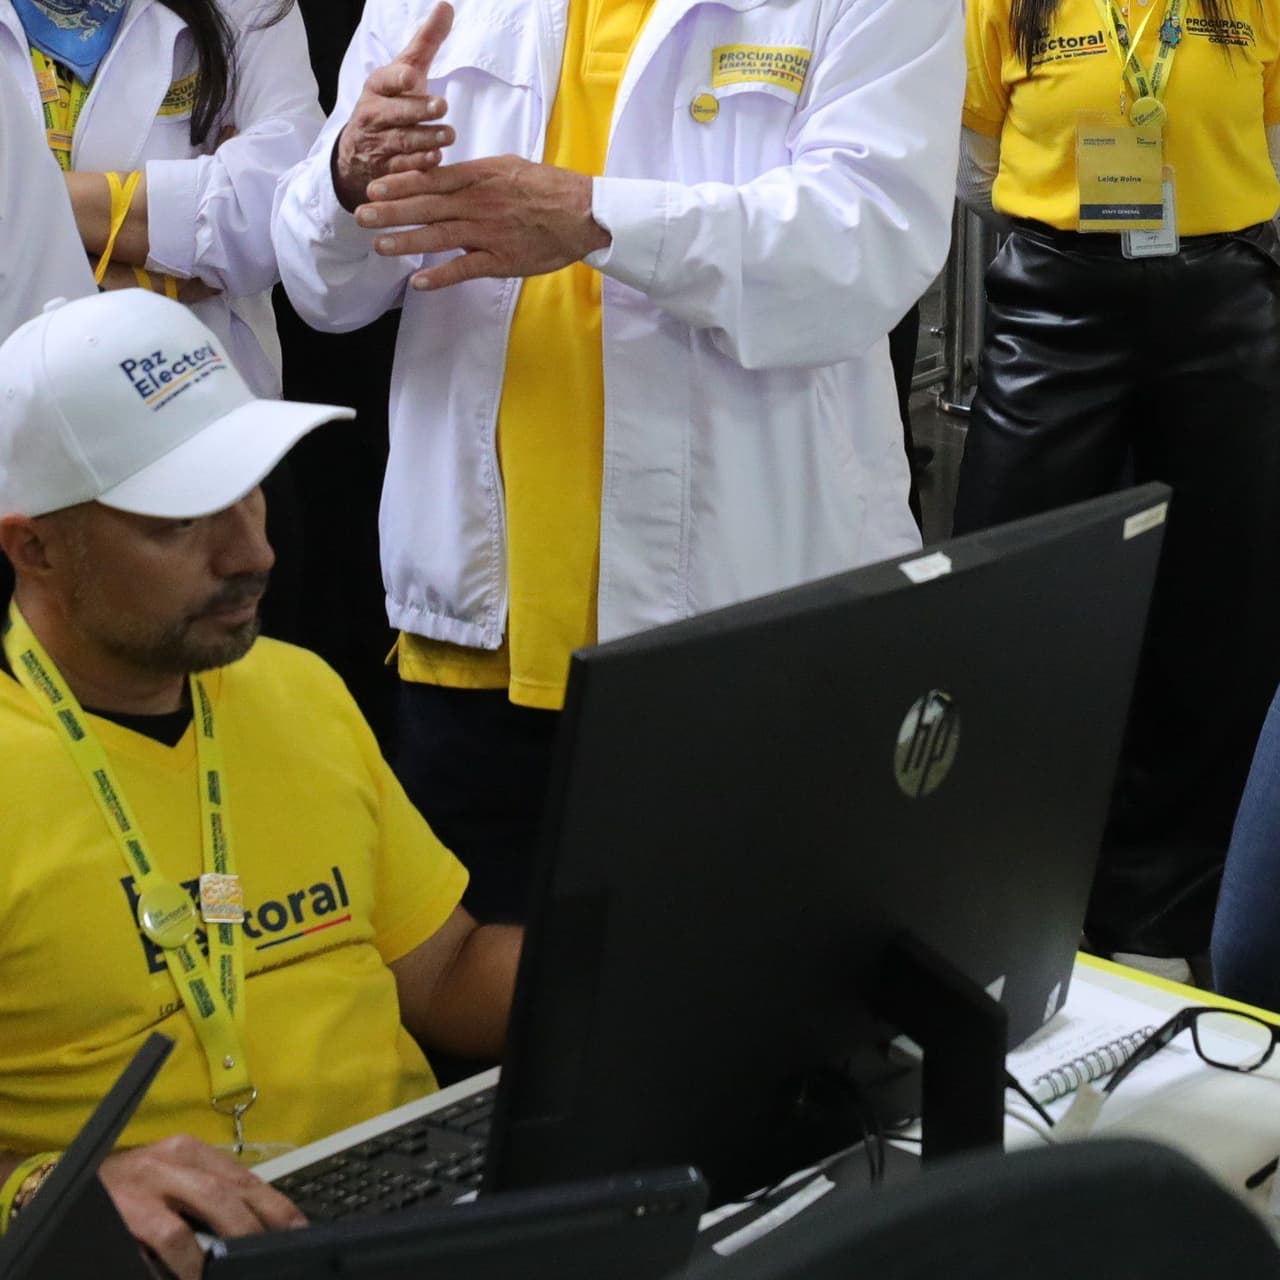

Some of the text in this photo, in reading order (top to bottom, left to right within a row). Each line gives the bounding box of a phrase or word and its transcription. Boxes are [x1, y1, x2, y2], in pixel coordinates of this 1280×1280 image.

[1030, 30, 1104, 57] lectoral
[720, 51, 811, 67] PROCURADUR
[119, 349, 167, 382] Paz
[901, 696, 950, 799] hp
